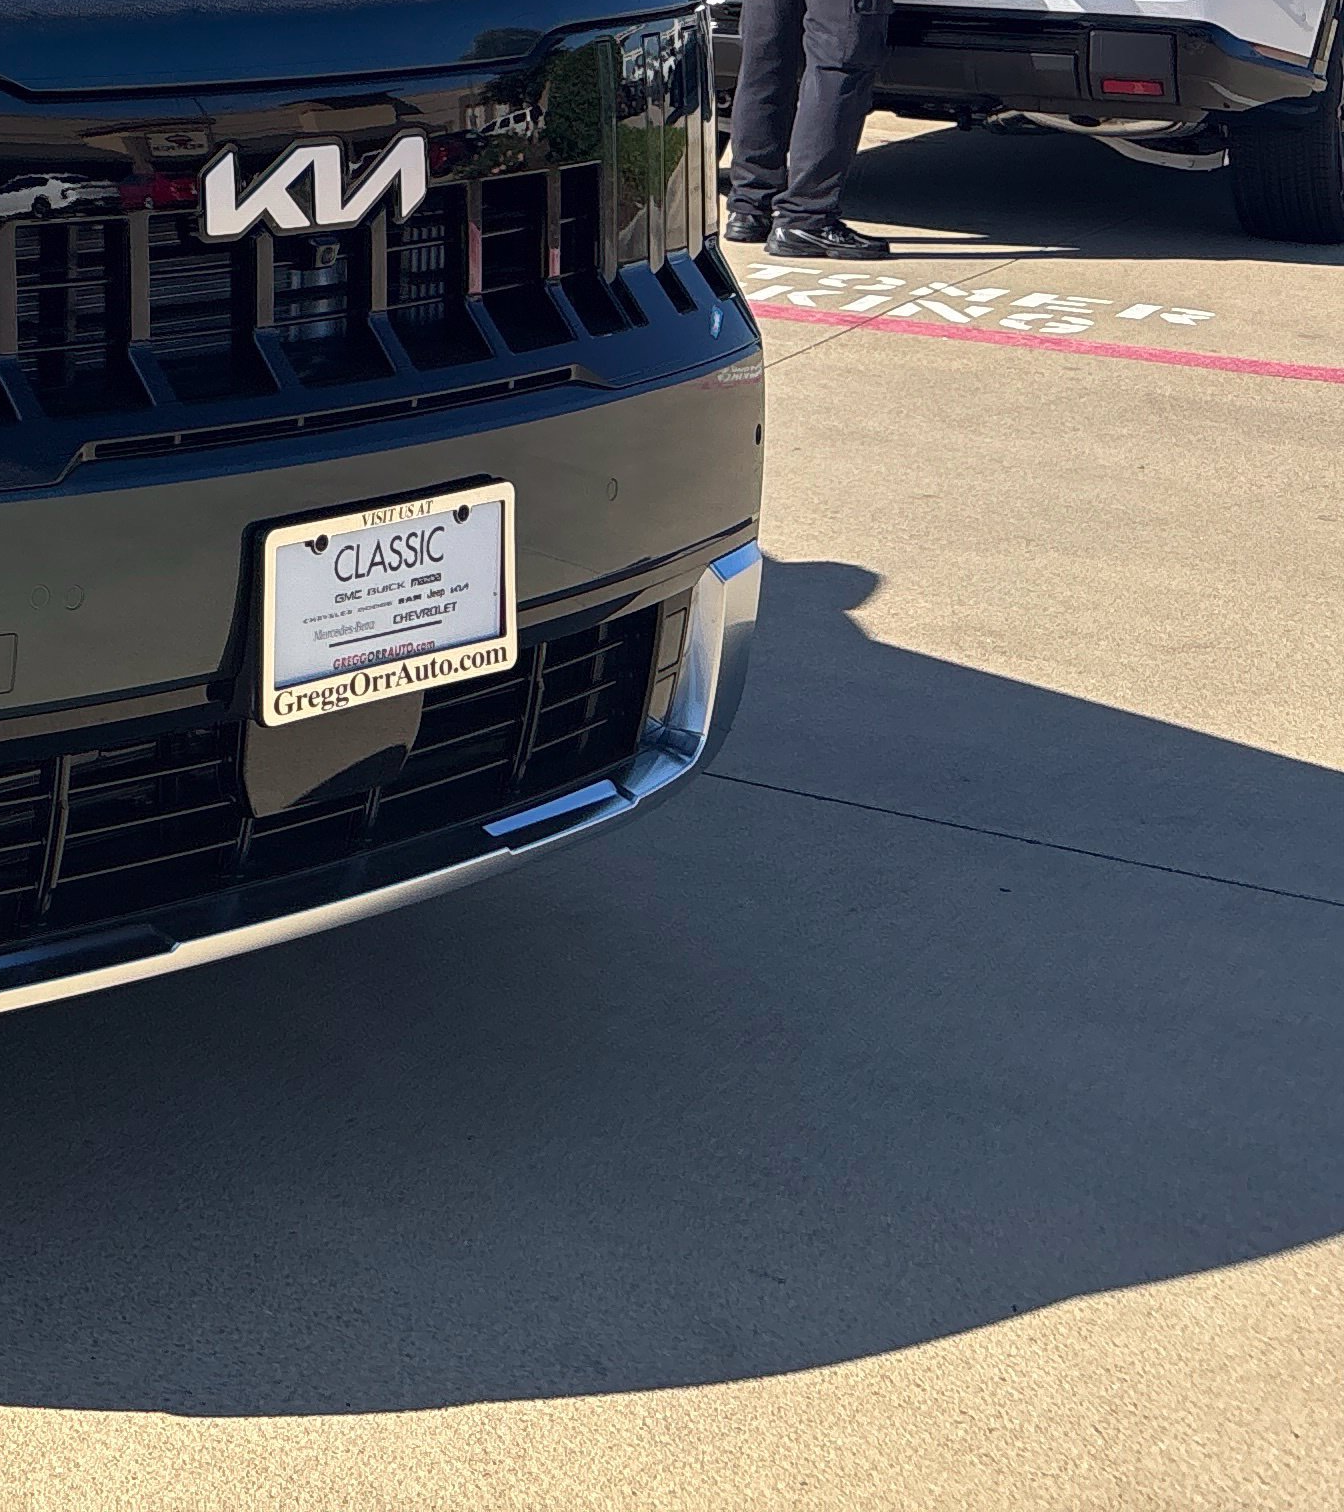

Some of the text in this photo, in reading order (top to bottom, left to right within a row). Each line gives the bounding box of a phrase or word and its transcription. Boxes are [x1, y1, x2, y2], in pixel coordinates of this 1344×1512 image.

[205, 136, 427, 237] KIA
[743, 284, 1095, 334] KING
[747, 262, 1216, 327] TOMER
[362, 500, 434, 527] VISIT US AT
[334, 525, 445, 582] CLASSIC
[334, 589, 362, 604] GMC
[366, 581, 407, 597] BUICK
[426, 587, 446, 600] Jeep
[392, 601, 458, 625] CHEVROLET
[333, 640, 436, 671] GREGGORRAUTO.com
[273, 644, 508, 717] GreggOrrAuto.com
